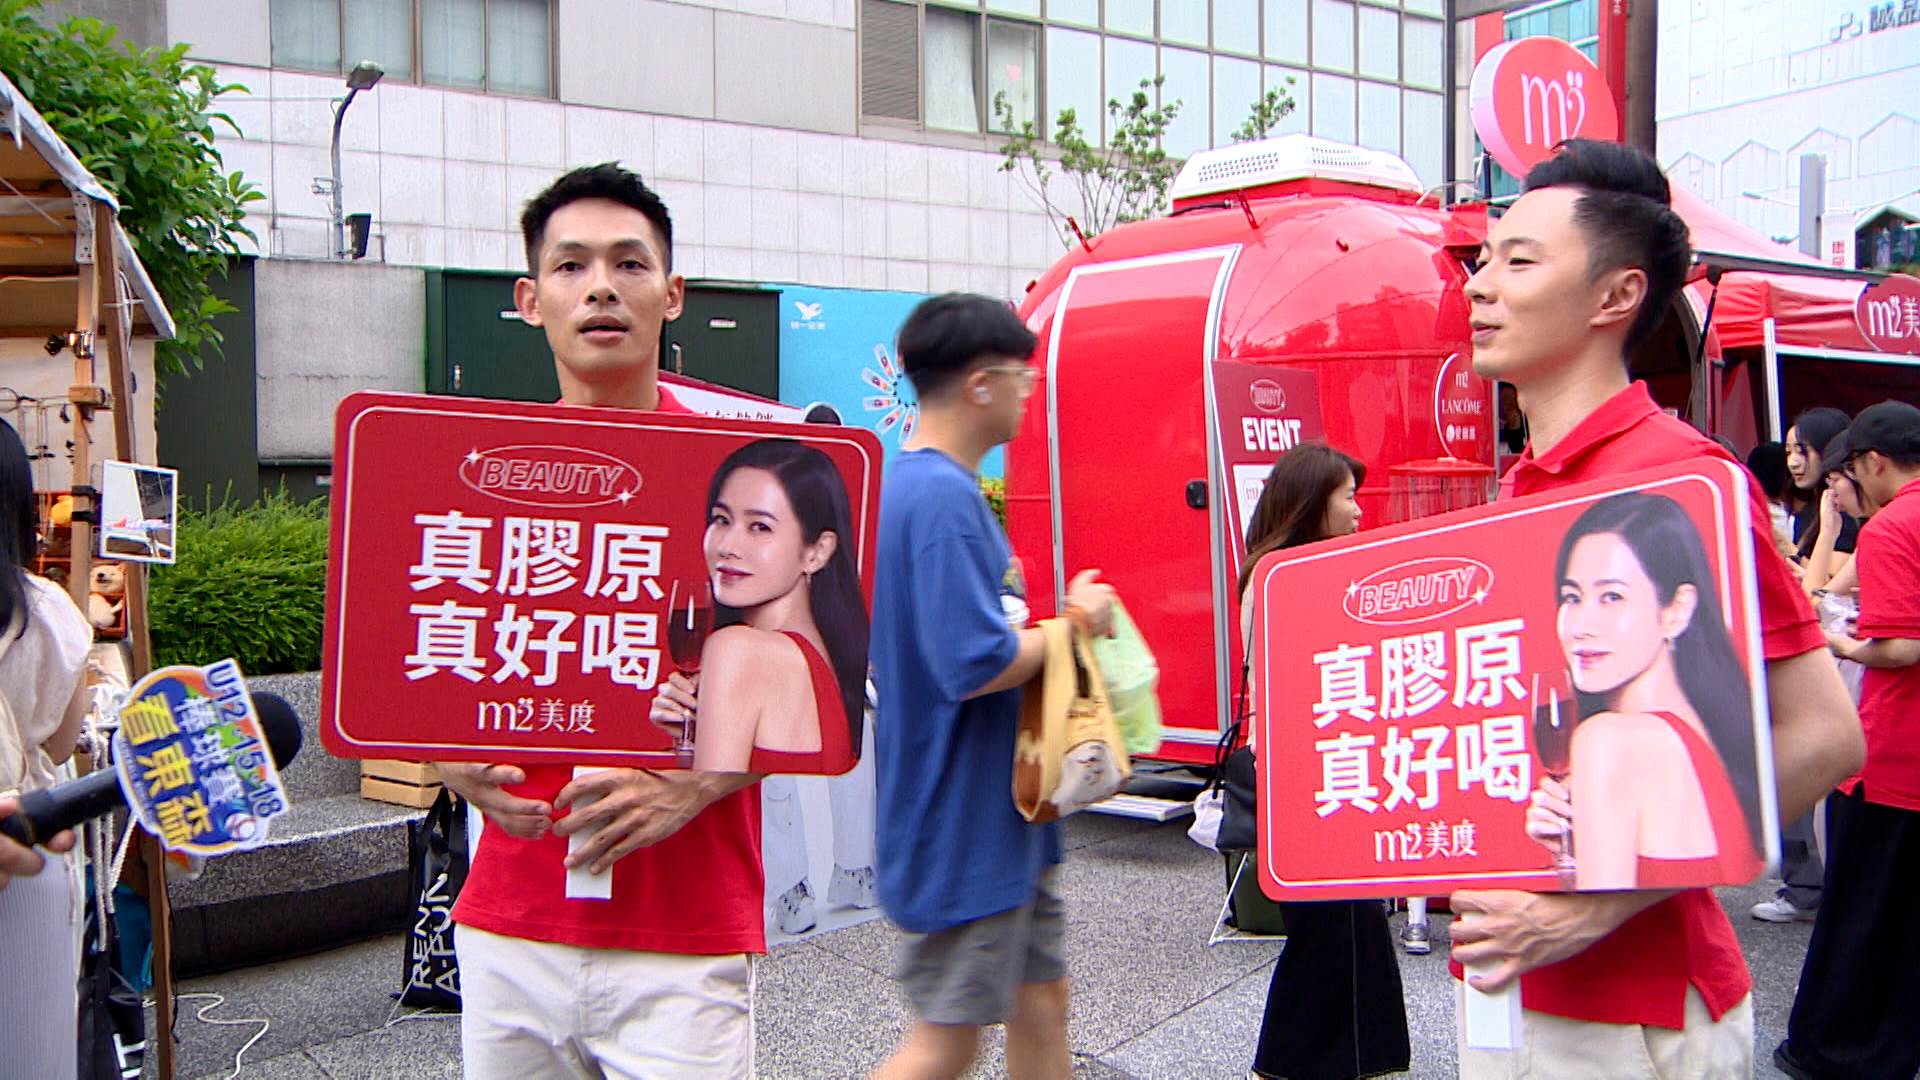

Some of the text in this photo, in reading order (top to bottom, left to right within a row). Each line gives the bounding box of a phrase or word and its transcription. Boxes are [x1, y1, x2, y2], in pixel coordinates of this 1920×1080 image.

[1241, 416, 1301, 451] EVENT
[1441, 398, 1482, 415] LANCÔME
[479, 457, 625, 496] BEAUTY
[408, 510, 671, 602] 真膠原
[1358, 566, 1477, 617] BEAUTY
[404, 600, 662, 690] 真好喝
[1312, 619, 1528, 728] 真膠原
[119, 692, 214, 847] 看東森
[174, 696, 244, 806] 棒球賽
[1314, 715, 1532, 818] 真好喝
